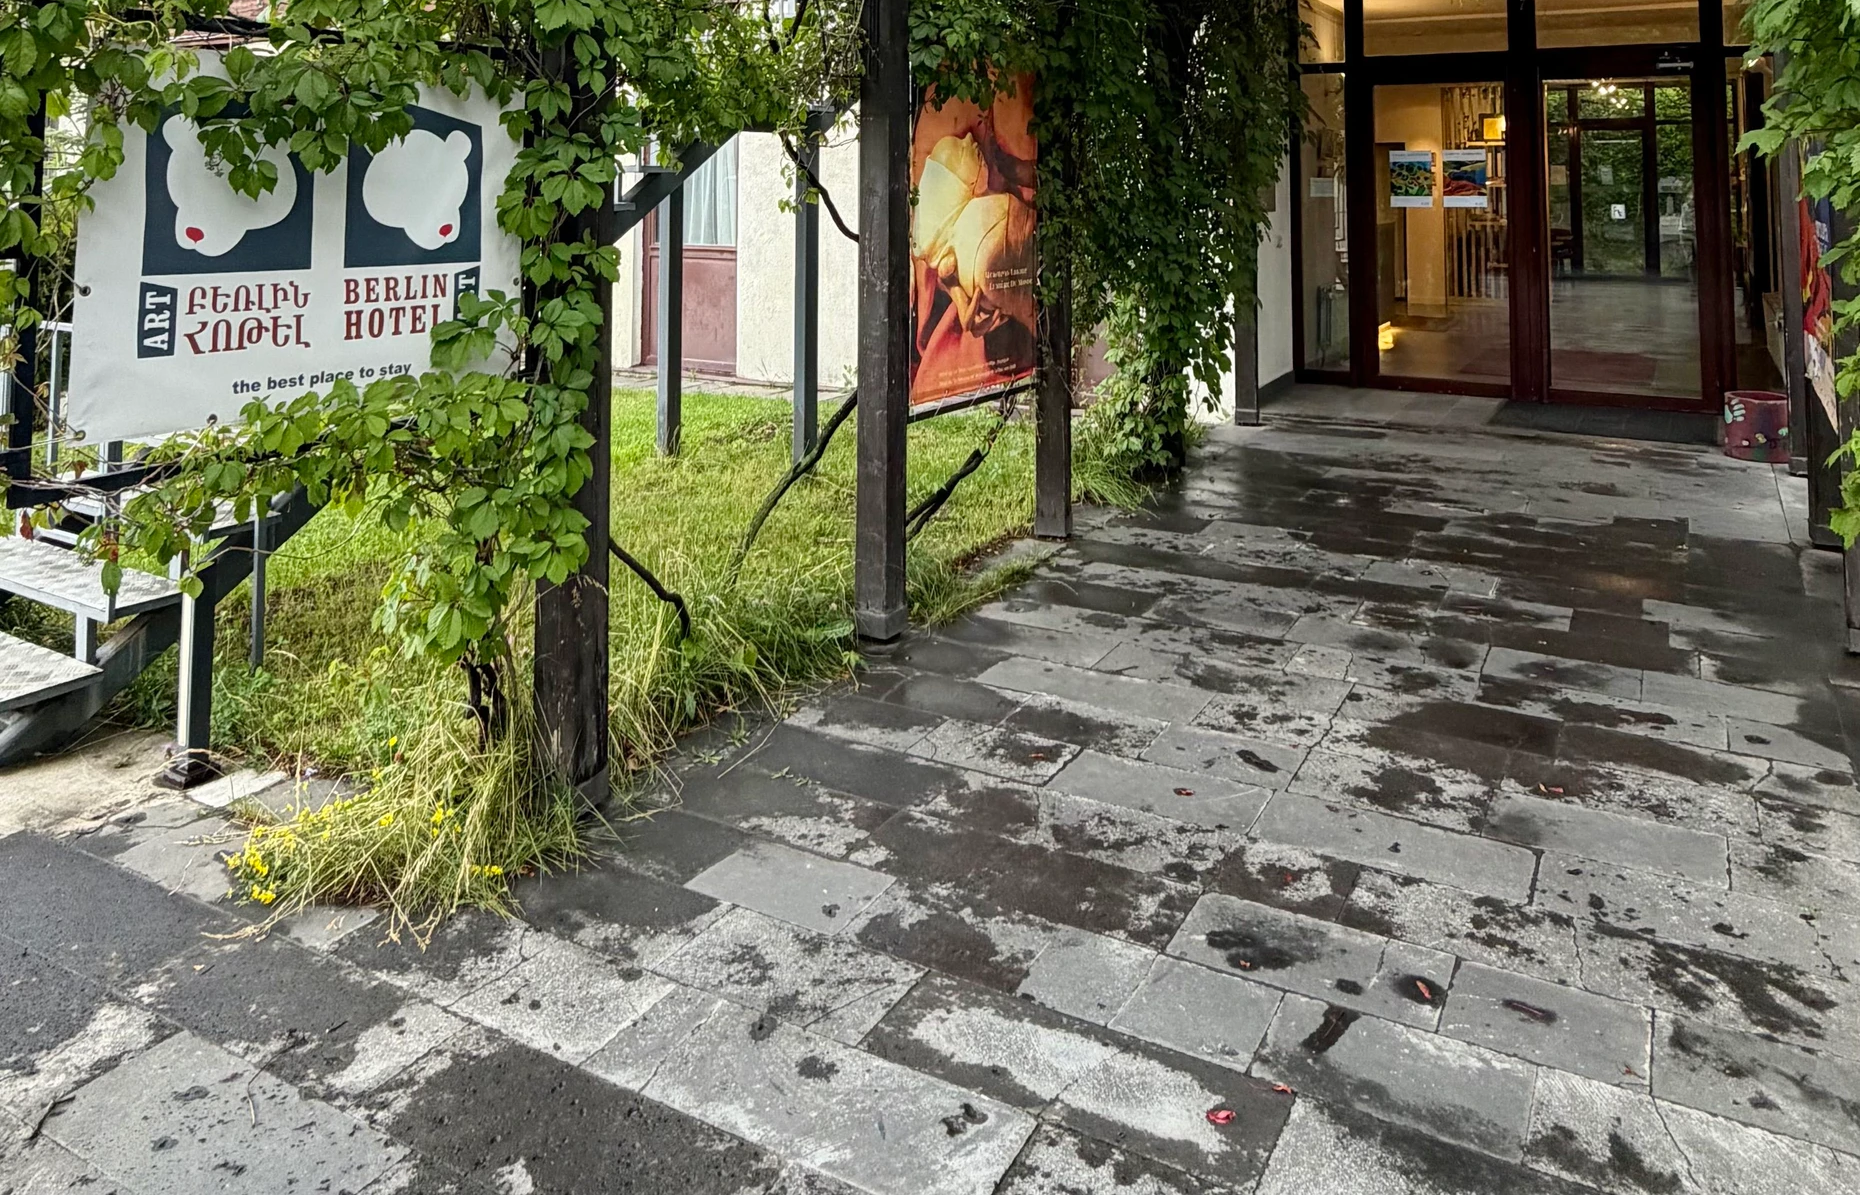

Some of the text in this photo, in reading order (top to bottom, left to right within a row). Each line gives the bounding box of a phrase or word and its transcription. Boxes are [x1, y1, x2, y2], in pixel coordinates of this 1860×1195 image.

[185, 280, 311, 316] ԲԵՌԼԻՆ
[343, 273, 449, 305] BERLIN
[143, 291, 171, 351] ART
[183, 314, 311, 355] ՀՈԹԵԼ
[232, 362, 412, 394] the best place to stay
